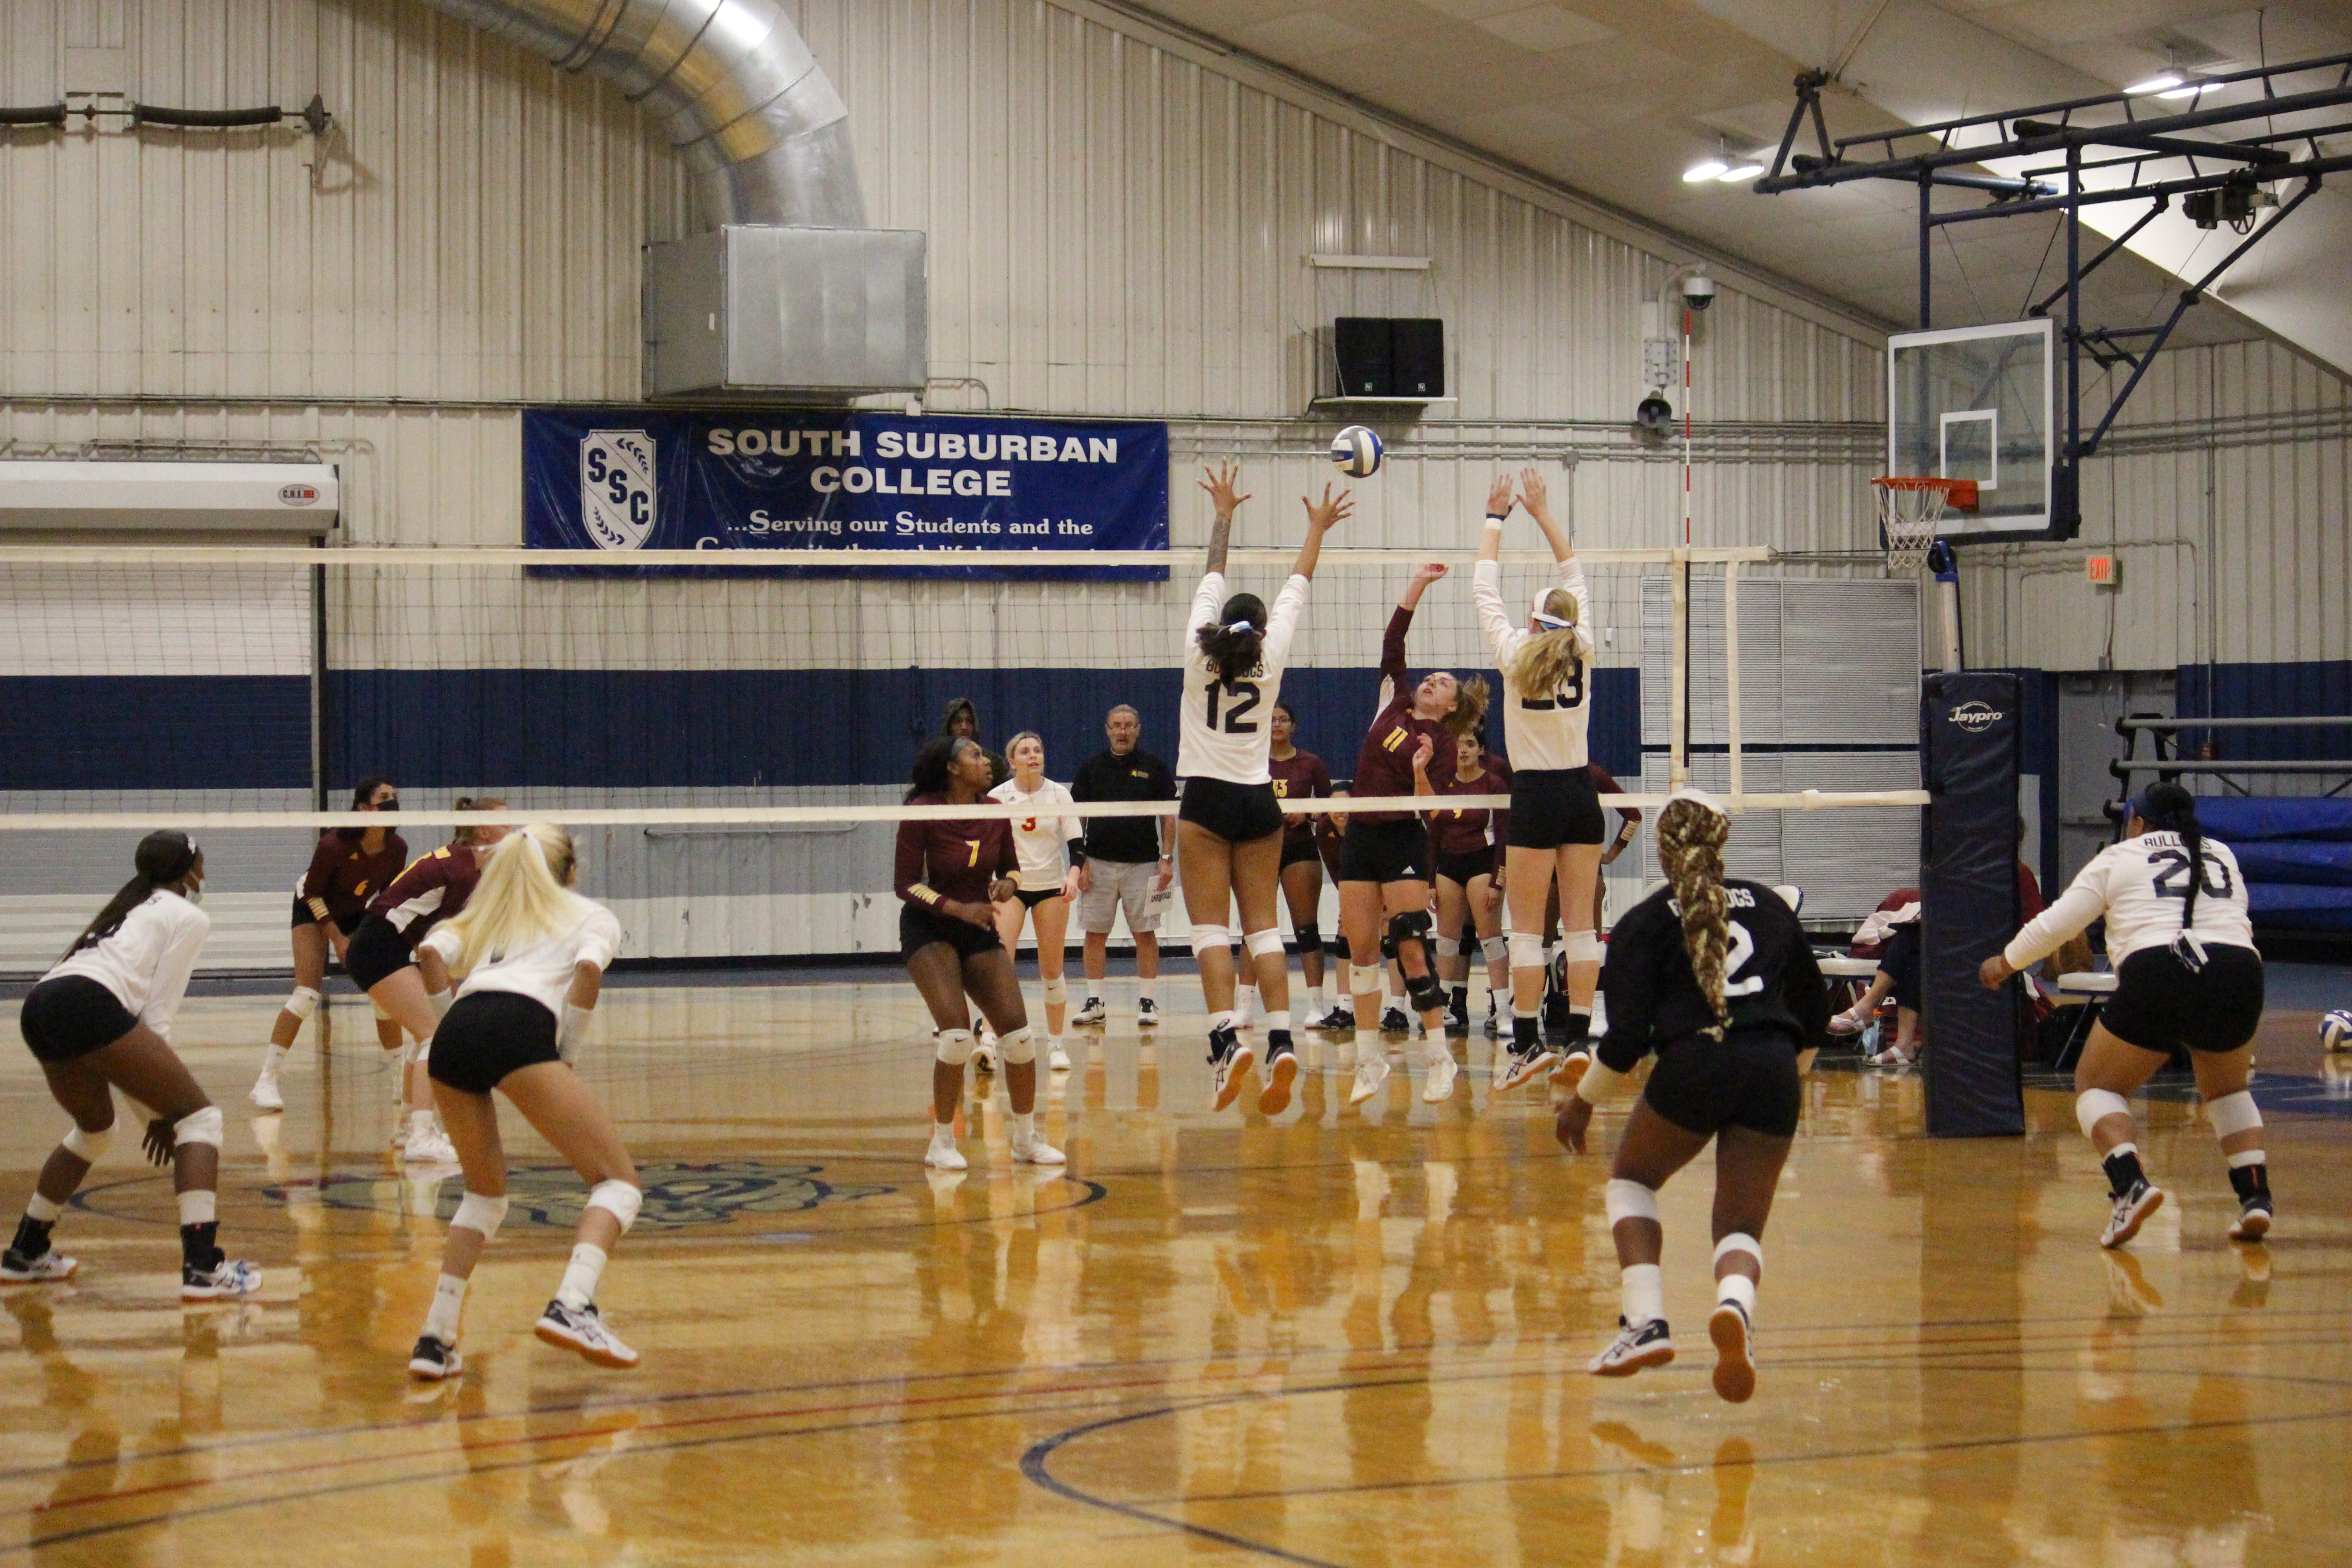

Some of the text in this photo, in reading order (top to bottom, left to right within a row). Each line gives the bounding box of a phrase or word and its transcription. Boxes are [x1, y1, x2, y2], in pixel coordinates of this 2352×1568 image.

[708, 428, 1117, 463] SOUTH SUBURBAN
[810, 466, 1011, 496] COLLEGE
[849, 520, 888, 532] our
[896, 511, 1001, 536] Students
[1009, 518, 1050, 534] and
[1057, 519, 1093, 535] the
[2090, 559, 2109, 579] EXIT
[1205, 679, 1260, 733] 12
[1948, 706, 2003, 723] Jaypro
[1382, 725, 1408, 753] 11
[1272, 779, 1288, 798] 13
[965, 840, 980, 867] 7
[2147, 849, 2233, 898] 20
